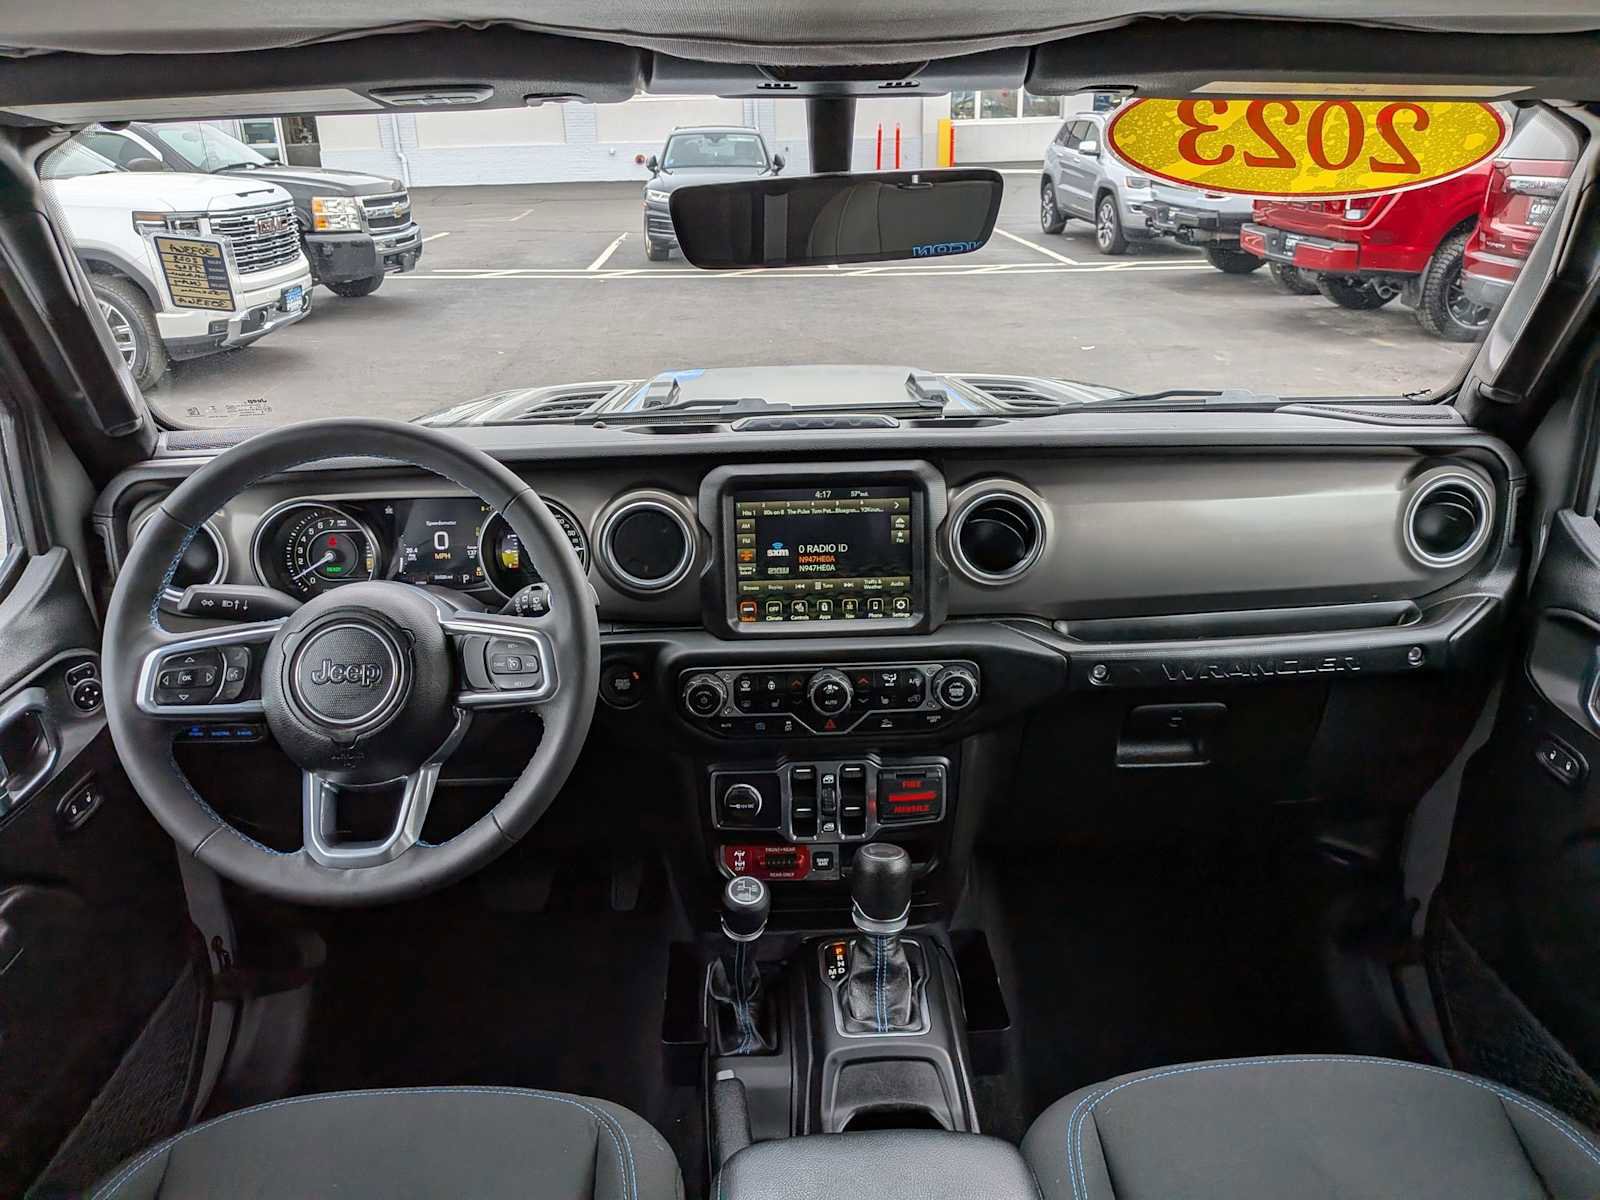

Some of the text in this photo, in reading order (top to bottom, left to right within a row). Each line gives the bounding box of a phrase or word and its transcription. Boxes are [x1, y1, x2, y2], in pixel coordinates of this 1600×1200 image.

[815, 490, 832, 499] 4:17
[434, 531, 449, 550] 0
[806, 544, 836, 553] RADIO
[838, 543, 848, 552] ID
[434, 552, 451, 560] MPH
[462, 574, 470, 584] P
[311, 659, 383, 687] Jeep
